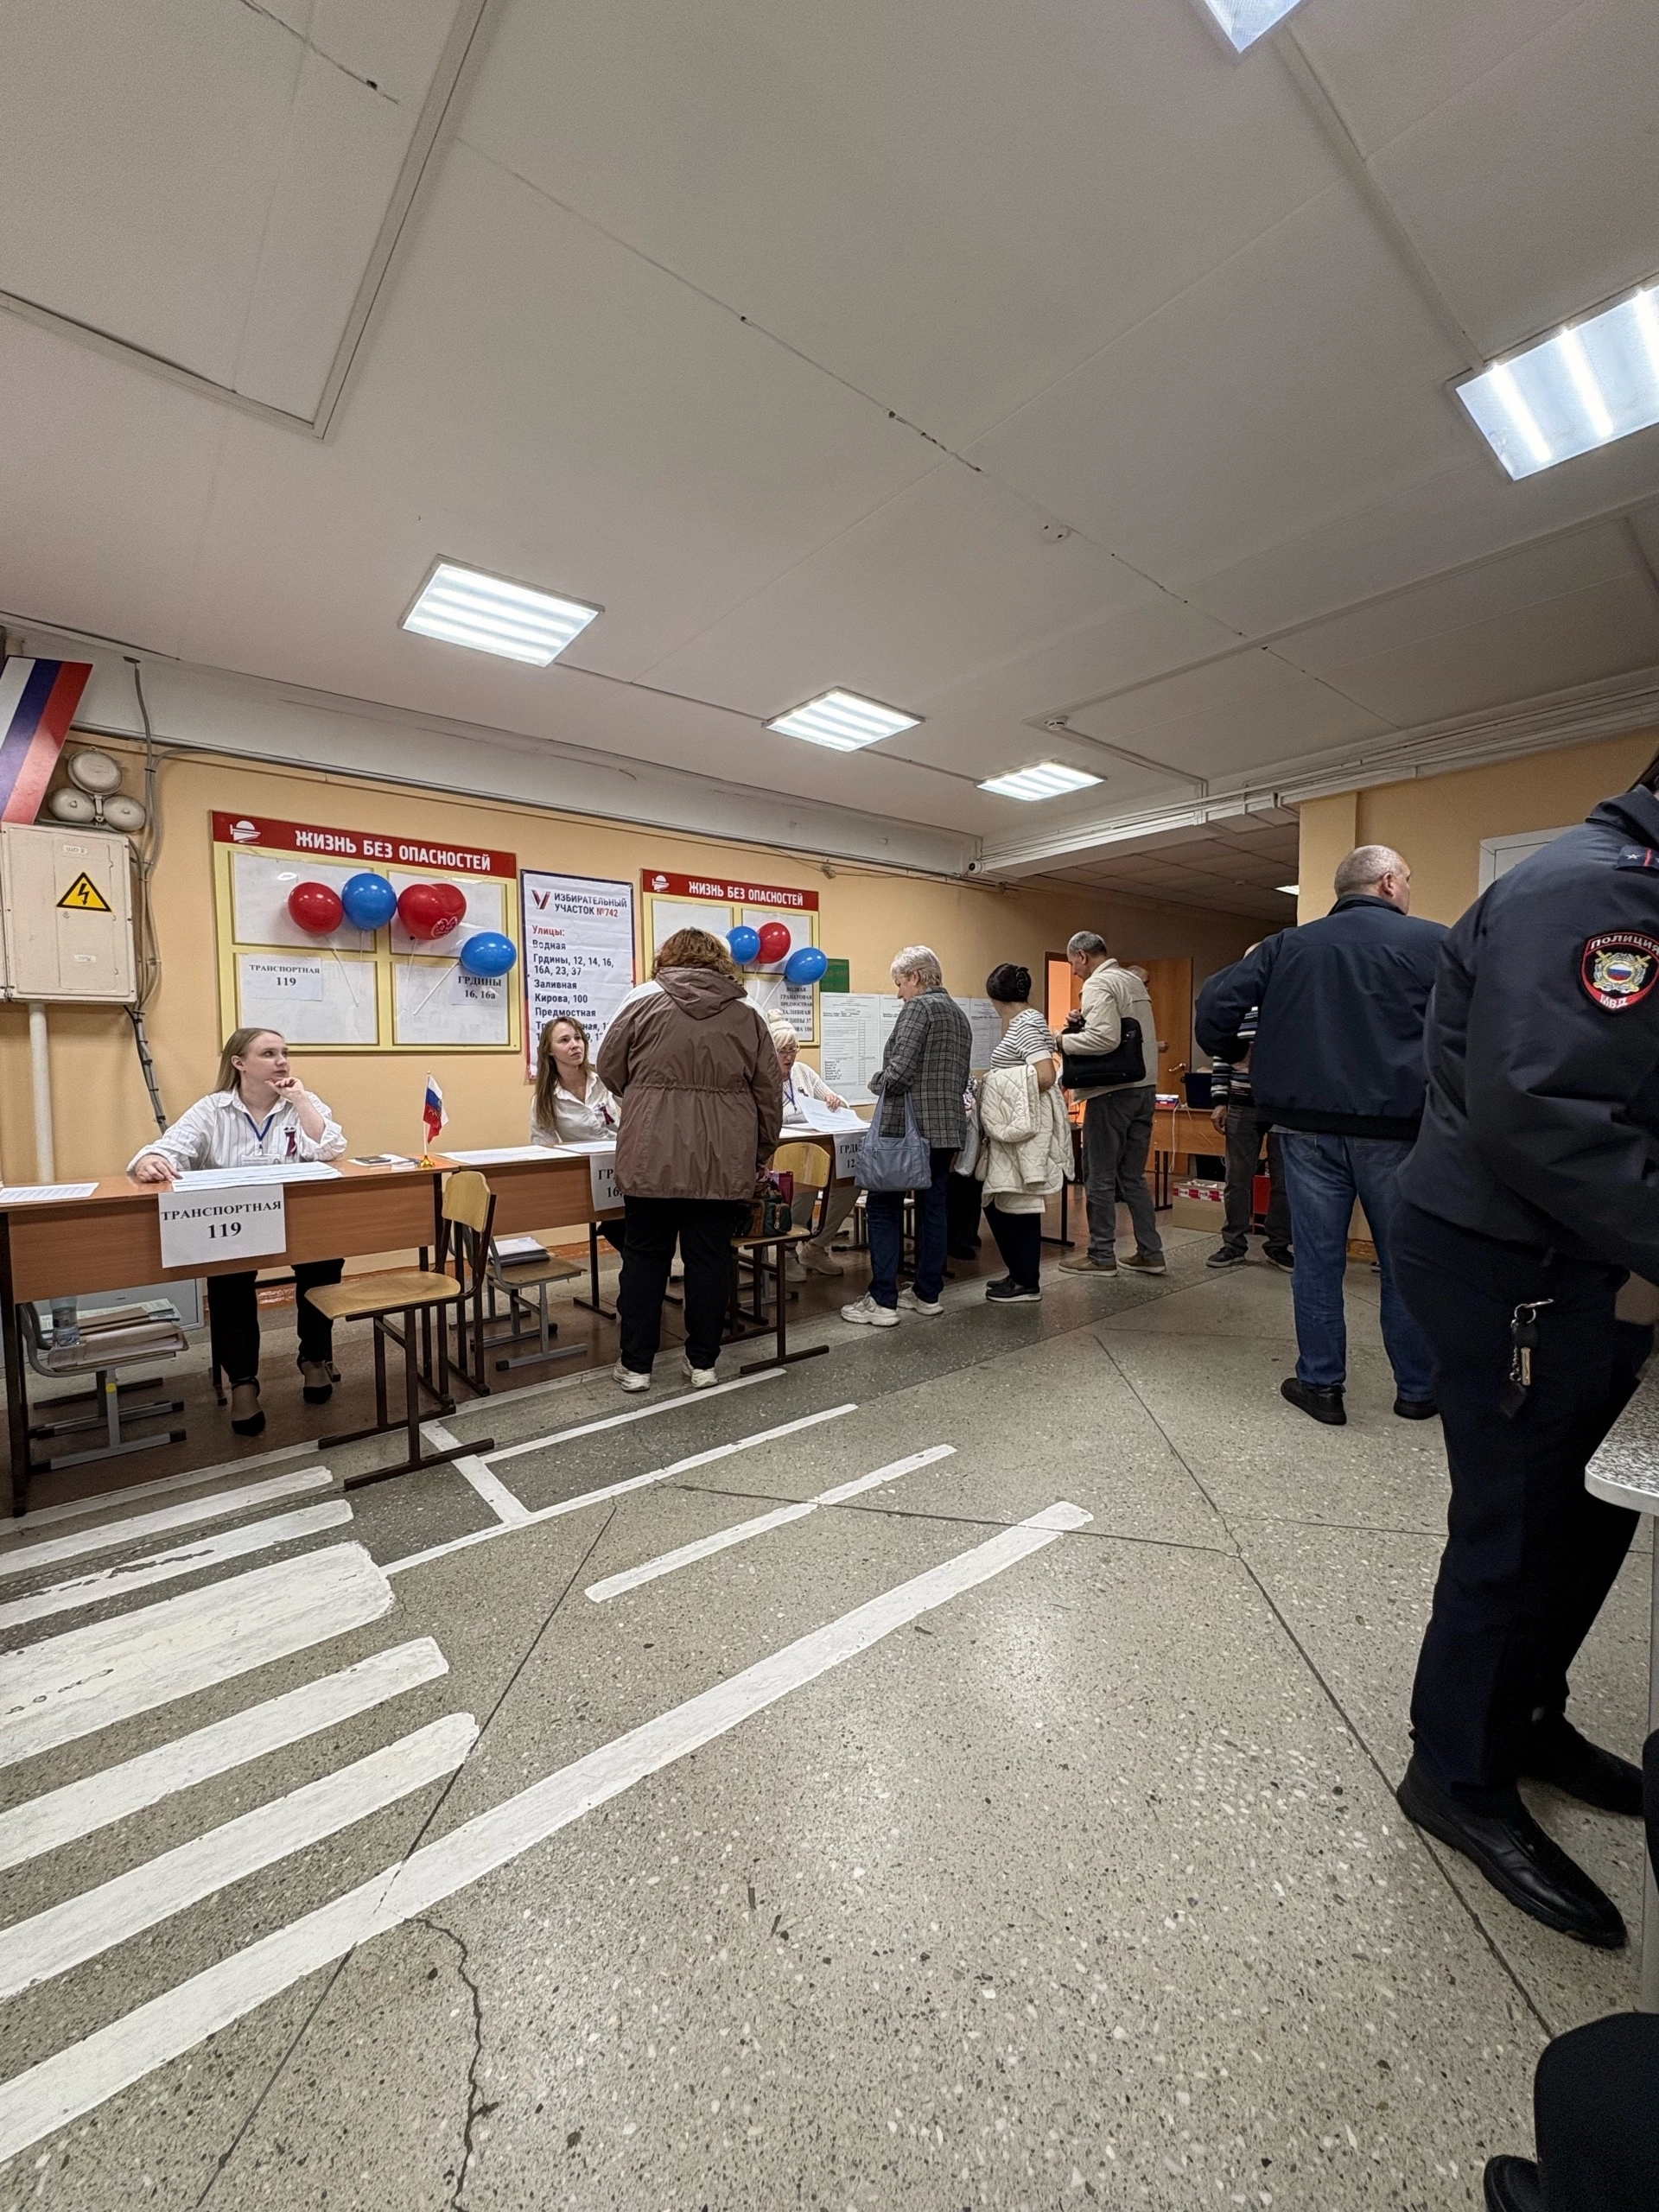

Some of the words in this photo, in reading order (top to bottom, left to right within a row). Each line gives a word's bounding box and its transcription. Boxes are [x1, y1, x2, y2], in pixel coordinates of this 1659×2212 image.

[295, 830, 357, 854] ЖИЗНЬ
[363, 840, 392, 859] БЕЗ
[398, 844, 491, 872] ОПАСНОСТЕЙ
[688, 880, 724, 898] ЖИЗНЬ
[727, 886, 746, 900] БЕЗ
[748, 888, 804, 906] ОПАСНОСТЕЙ
[554, 892, 627, 908] ИЗБИРАТЕЛЬНЫЙ
[555, 903, 595, 915] УЧАСТОК
[596, 907, 619, 918] №742
[532, 925, 565, 937] Улицы:
[532, 939, 566, 950] Водная
[1591, 935, 1659, 956] ПОЛИЦИЯ
[533, 953, 571, 966] Грдины,
[574, 956, 586, 967] 12,
[588, 957, 601, 968] 14,
[602, 957, 614, 969] 16,
[249, 964, 321, 975] ТРАНСПОРТНАЯ
[534, 965, 553, 976] 16А,
[556, 966, 569, 977] 23,
[571, 967, 582, 976] 37
[276, 976, 296, 986] 119
[458, 976, 502, 987] ГРДИНЫ
[534, 979, 577, 989] Заливная
[465, 989, 478, 1000] 16,
[480, 990, 496, 1000] 16а
[535, 993, 570, 1005] Кирова,
[574, 995, 588, 1003] 100
[1599, 994, 1629, 1009] МВД
[535, 1007, 596, 1018] Предмостная
[598, 1168, 615, 1180] ГР
[161, 1201, 282, 1221] ТРАНСПОРТНАЯ
[207, 1222, 242, 1239] 119
